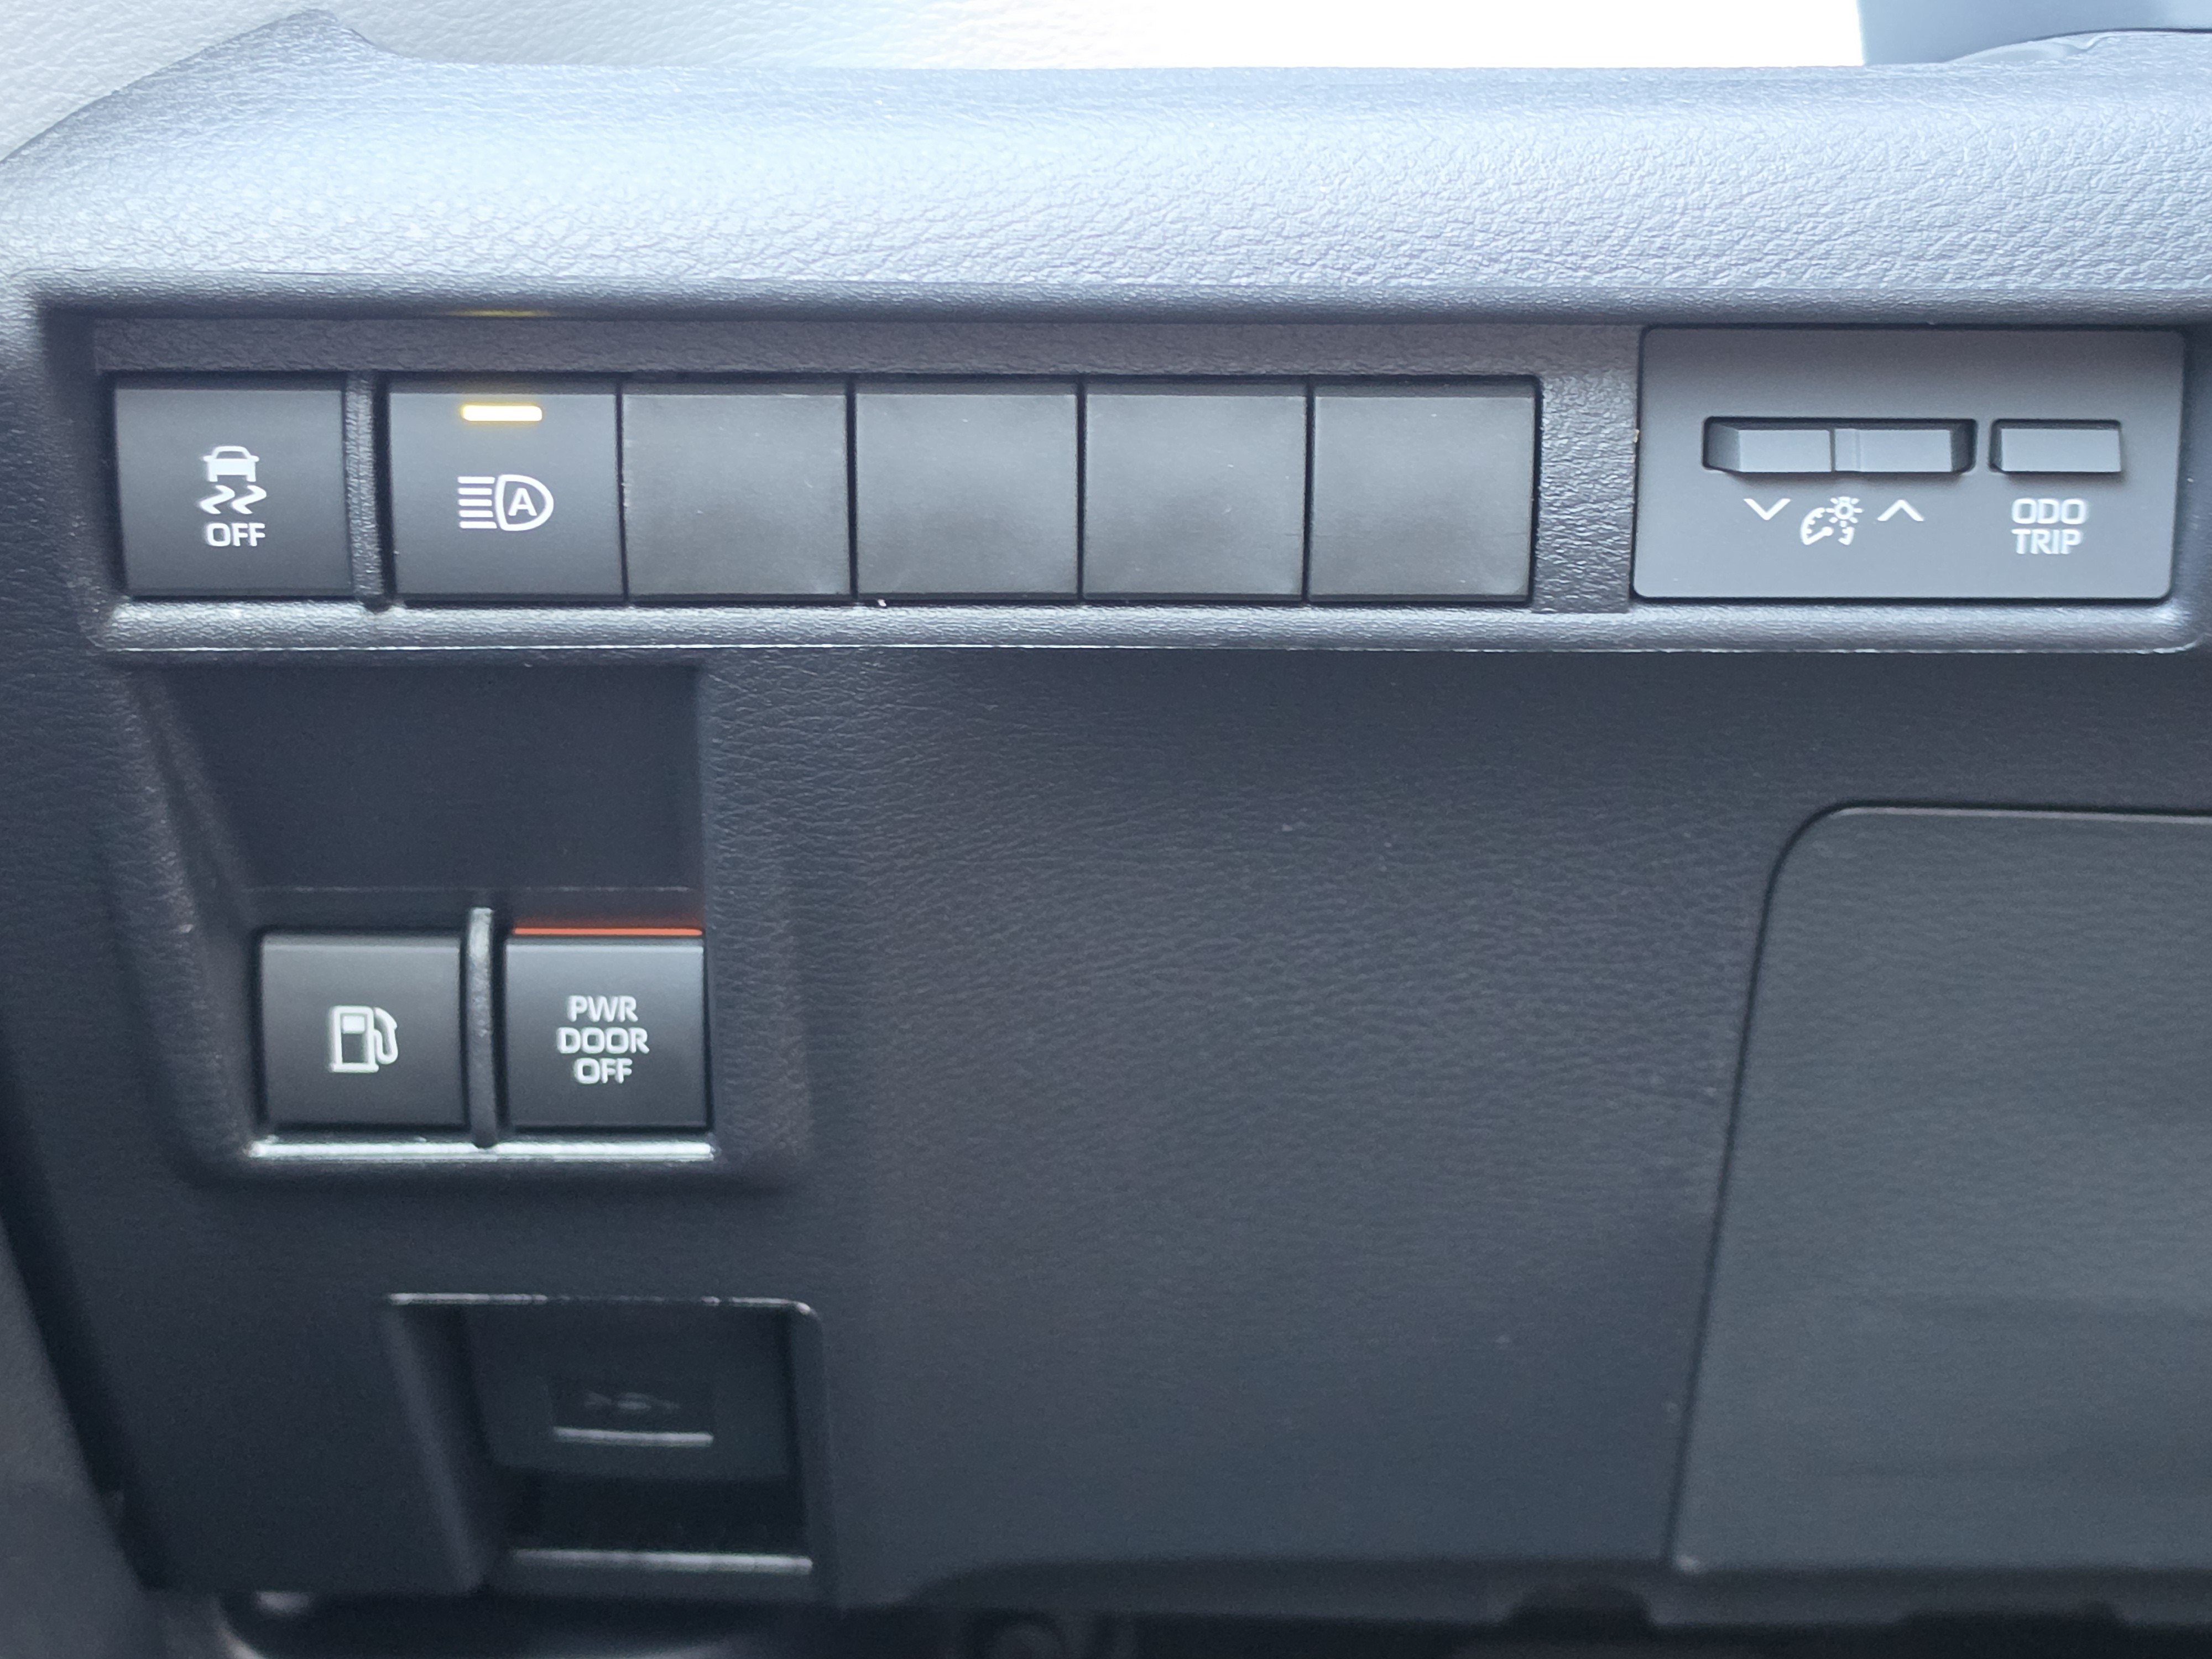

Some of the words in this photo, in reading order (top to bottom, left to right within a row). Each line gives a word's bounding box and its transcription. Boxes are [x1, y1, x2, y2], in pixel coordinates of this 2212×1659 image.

[508, 488, 537, 516] A
[2011, 498, 2088, 524] ODO
[205, 522, 265, 547] OFF
[2011, 528, 2083, 554] TRIP
[566, 995, 638, 1022] PWR
[556, 1027, 650, 1054] DOOR
[573, 1057, 633, 1084] OFF
